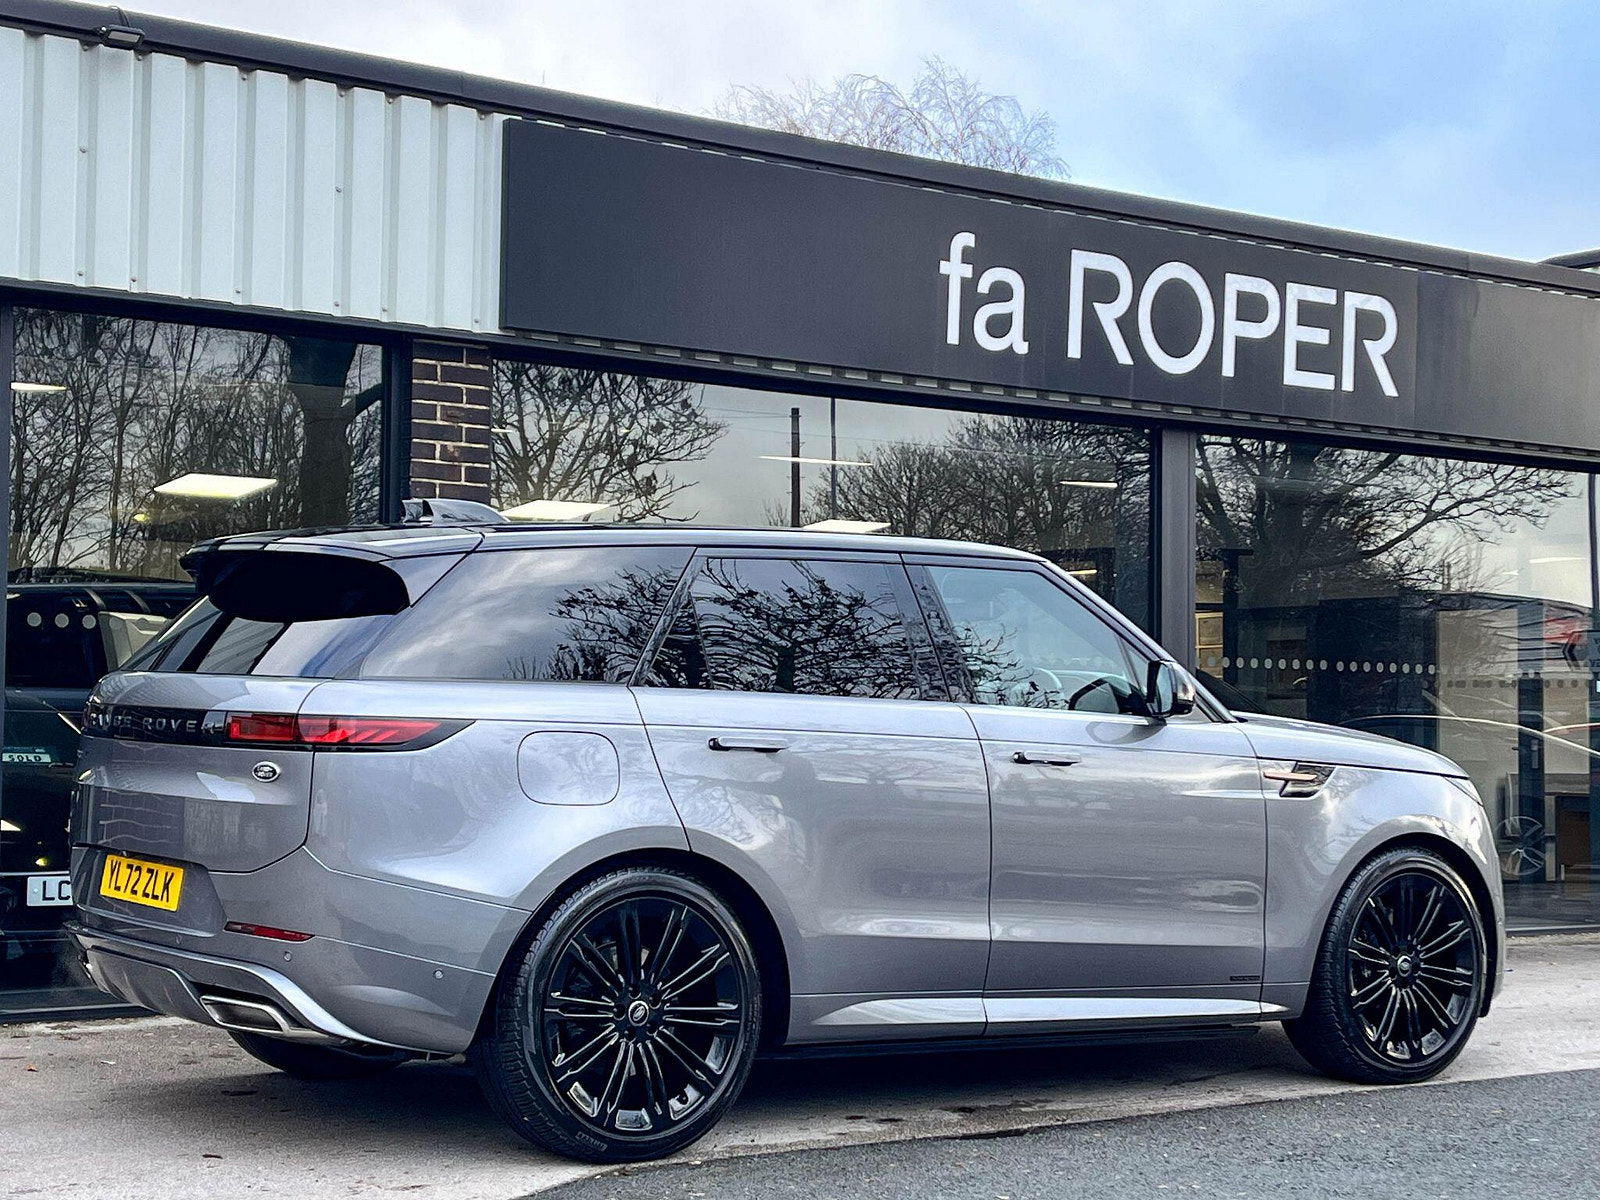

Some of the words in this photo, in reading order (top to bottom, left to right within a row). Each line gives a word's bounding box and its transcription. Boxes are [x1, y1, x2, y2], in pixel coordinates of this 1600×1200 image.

[939, 231, 1029, 354] fa
[1067, 249, 1399, 397] ROPER
[8, 754, 42, 762] SOLD
[108, 859, 142, 895] YL72
[142, 868, 175, 902] ZLK
